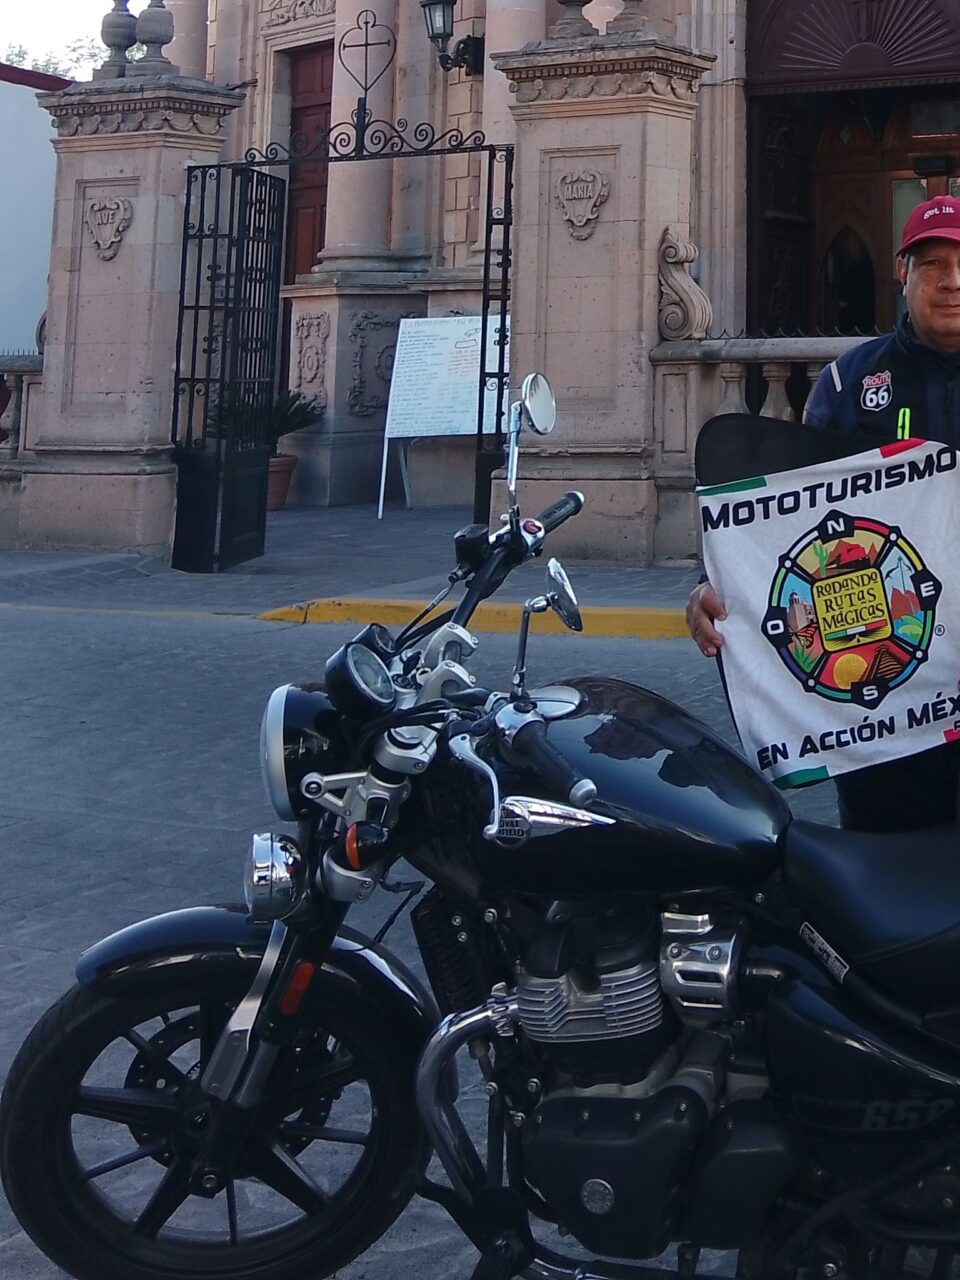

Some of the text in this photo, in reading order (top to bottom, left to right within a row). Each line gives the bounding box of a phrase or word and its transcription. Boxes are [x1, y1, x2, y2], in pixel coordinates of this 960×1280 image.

[565, 184, 593, 200] MARIA
[96, 211, 116, 225] AVE
[866, 386, 888, 407] 66
[702, 447, 957, 532] MOTOTURISMO
[828, 518, 845, 532] N
[921, 581, 937, 596] E
[862, 685, 878, 699] S
[756, 742, 790, 771] EN
[799, 715, 895, 758] ACCIÓN
